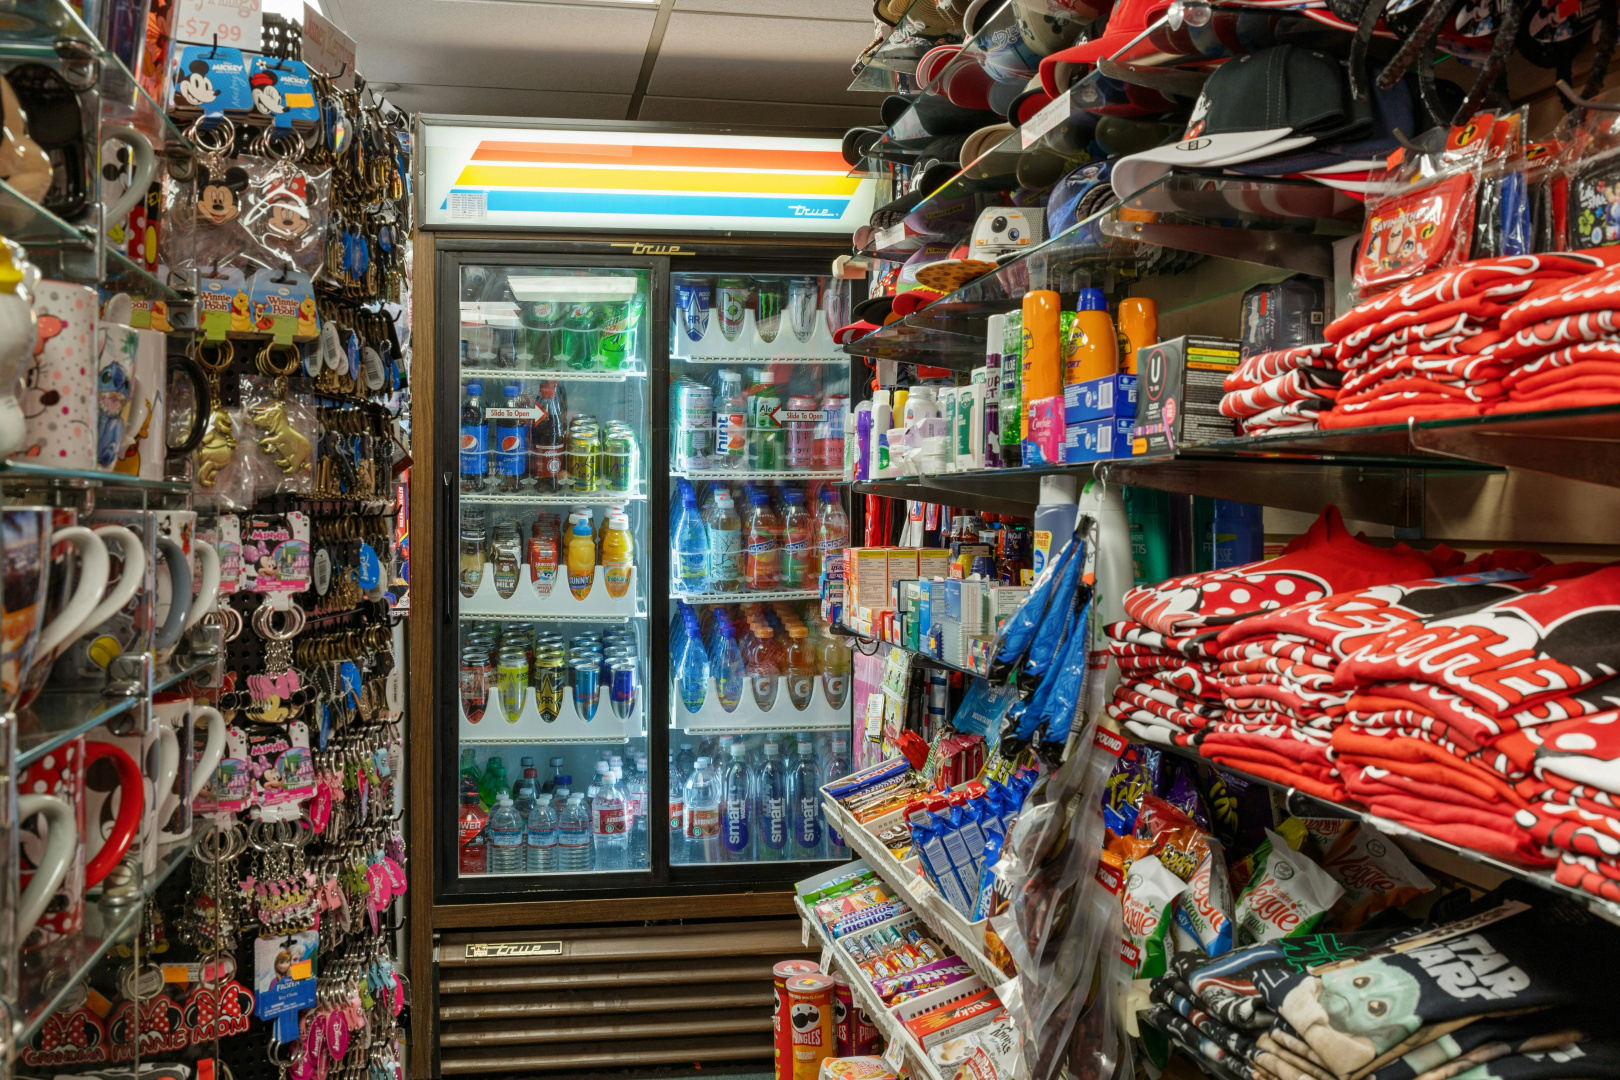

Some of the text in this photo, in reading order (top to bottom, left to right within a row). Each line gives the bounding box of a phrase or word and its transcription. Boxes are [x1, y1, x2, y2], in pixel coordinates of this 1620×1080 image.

[212, 63, 243, 72] MICKEY
[280, 75, 309, 85] MICKEY
[131, 301, 150, 310] ooh
[201, 292, 232, 302] Winnie
[267, 296, 299, 307] Winnie
[203, 301, 228, 311] Pooh
[272, 306, 297, 317] Pooh
[1151, 356, 1161, 383] U
[490, 409, 530, 418] Slide To Open
[717, 416, 728, 453] hint
[252, 529, 290, 541] MINNIE
[251, 740, 290, 756] MINNIE
[1096, 730, 1122, 752] POUND
[458, 820, 482, 830] WER
[729, 798, 741, 845] smart
[769, 798, 782, 843] smart
[801, 797, 814, 842] smart
[1269, 885, 1293, 906] Garden
[842, 911, 894, 934] mentos
[844, 905, 895, 925] mentos
[1123, 893, 1157, 938] eggie
[276, 981, 300, 992] FROZEN
[190, 1015, 249, 1044] MOM
[26, 1047, 104, 1066] GRANDMA
